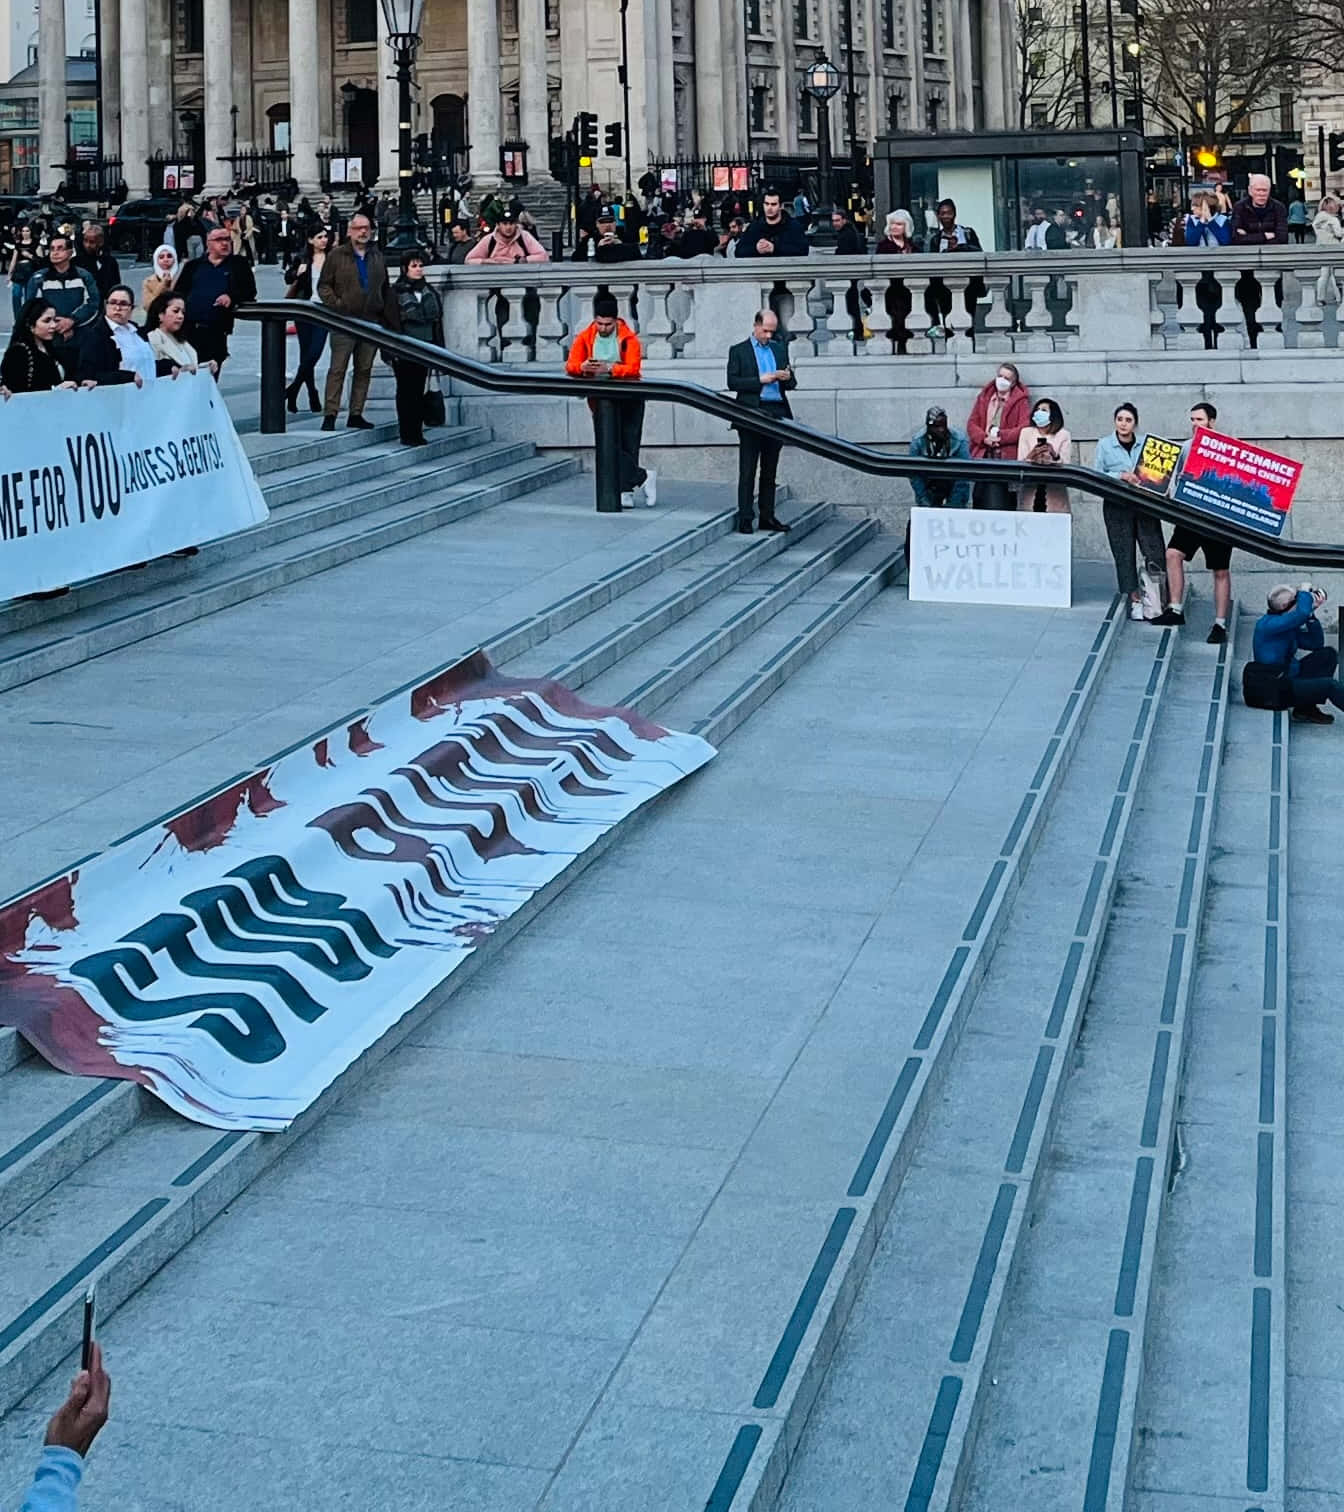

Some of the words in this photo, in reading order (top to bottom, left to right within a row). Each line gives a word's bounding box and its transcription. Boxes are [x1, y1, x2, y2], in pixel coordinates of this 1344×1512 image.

[1144, 437, 1180, 455] STOP
[1200, 435, 1238, 457] DON'T
[1239, 448, 1296, 478] FINANCE
[1143, 452, 1174, 472] WAR
[1197, 446, 1236, 469] PUTIN'S
[1236, 461, 1258, 476] WAR
[1257, 469, 1291, 487] CHEST!
[30, 464, 67, 533] FOR
[66, 432, 121, 523] YOU
[120, 446, 176, 494] LADIES
[167, 441, 187, 479] &
[182, 432, 224, 477] GENTS!
[927, 517, 1030, 539] BLOCK
[934, 543, 1018, 559] PUTIN
[922, 561, 1065, 591] WALLETS
[69, 854, 403, 1064] STOP
